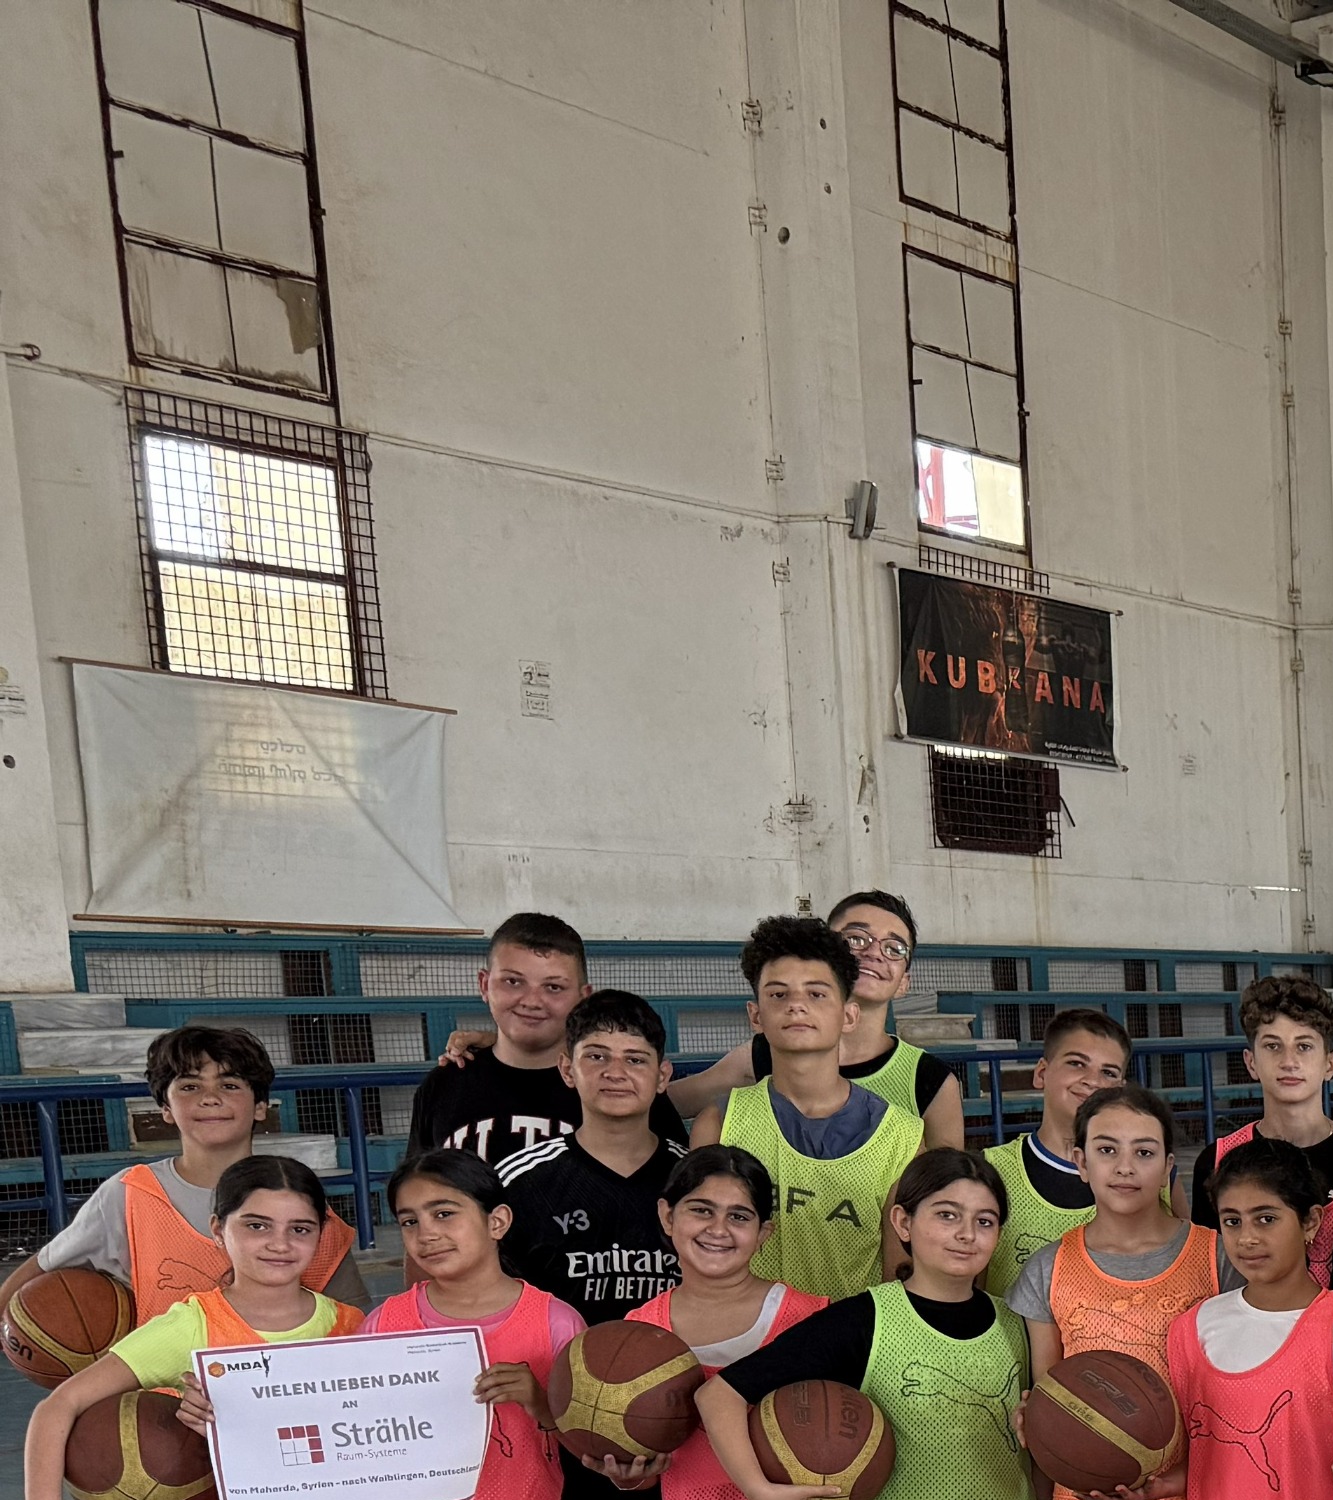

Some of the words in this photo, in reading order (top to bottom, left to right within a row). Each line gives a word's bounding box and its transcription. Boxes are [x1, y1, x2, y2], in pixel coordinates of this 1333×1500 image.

[553, 1209, 590, 1235] Y-3
[251, 1381, 317, 1399] VIELEN
[321, 1375, 384, 1393] LIEBEN
[388, 1370, 440, 1386] DANK
[342, 1400, 358, 1409] AN
[331, 1415, 434, 1448] Strähle
[337, 1447, 408, 1461] Raum-Systeme
[229, 1488, 248, 1496] von
[301, 1480, 334, 1492] Syrien
[342, 1476, 367, 1486] nach
